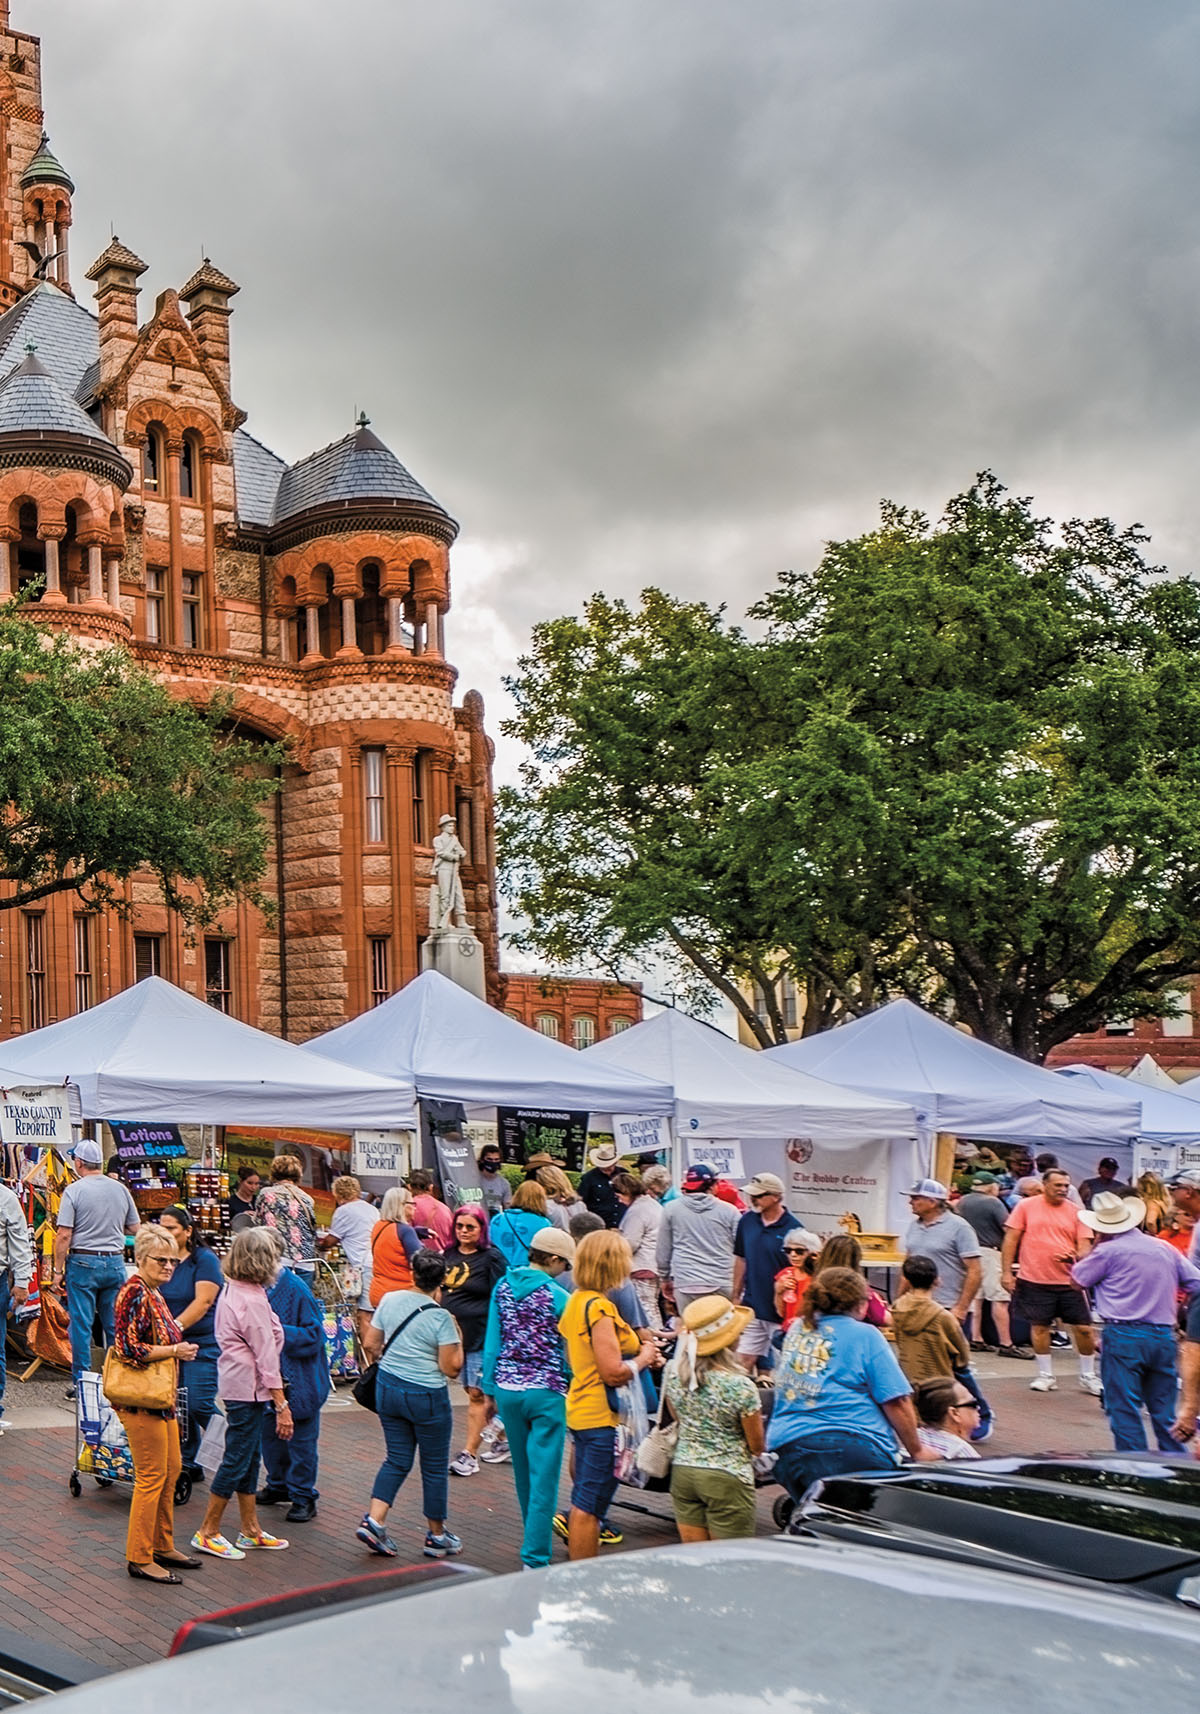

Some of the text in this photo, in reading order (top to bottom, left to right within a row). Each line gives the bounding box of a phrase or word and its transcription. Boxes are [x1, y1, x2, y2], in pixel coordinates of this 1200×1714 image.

[3, 1105, 63, 1120] TEXAS COUNTRY
[15, 1118, 57, 1137] REPORTER
[119, 1128, 174, 1142] Lotions
[118, 1142, 187, 1158] and Soaps
[792, 1171, 810, 1182] The
